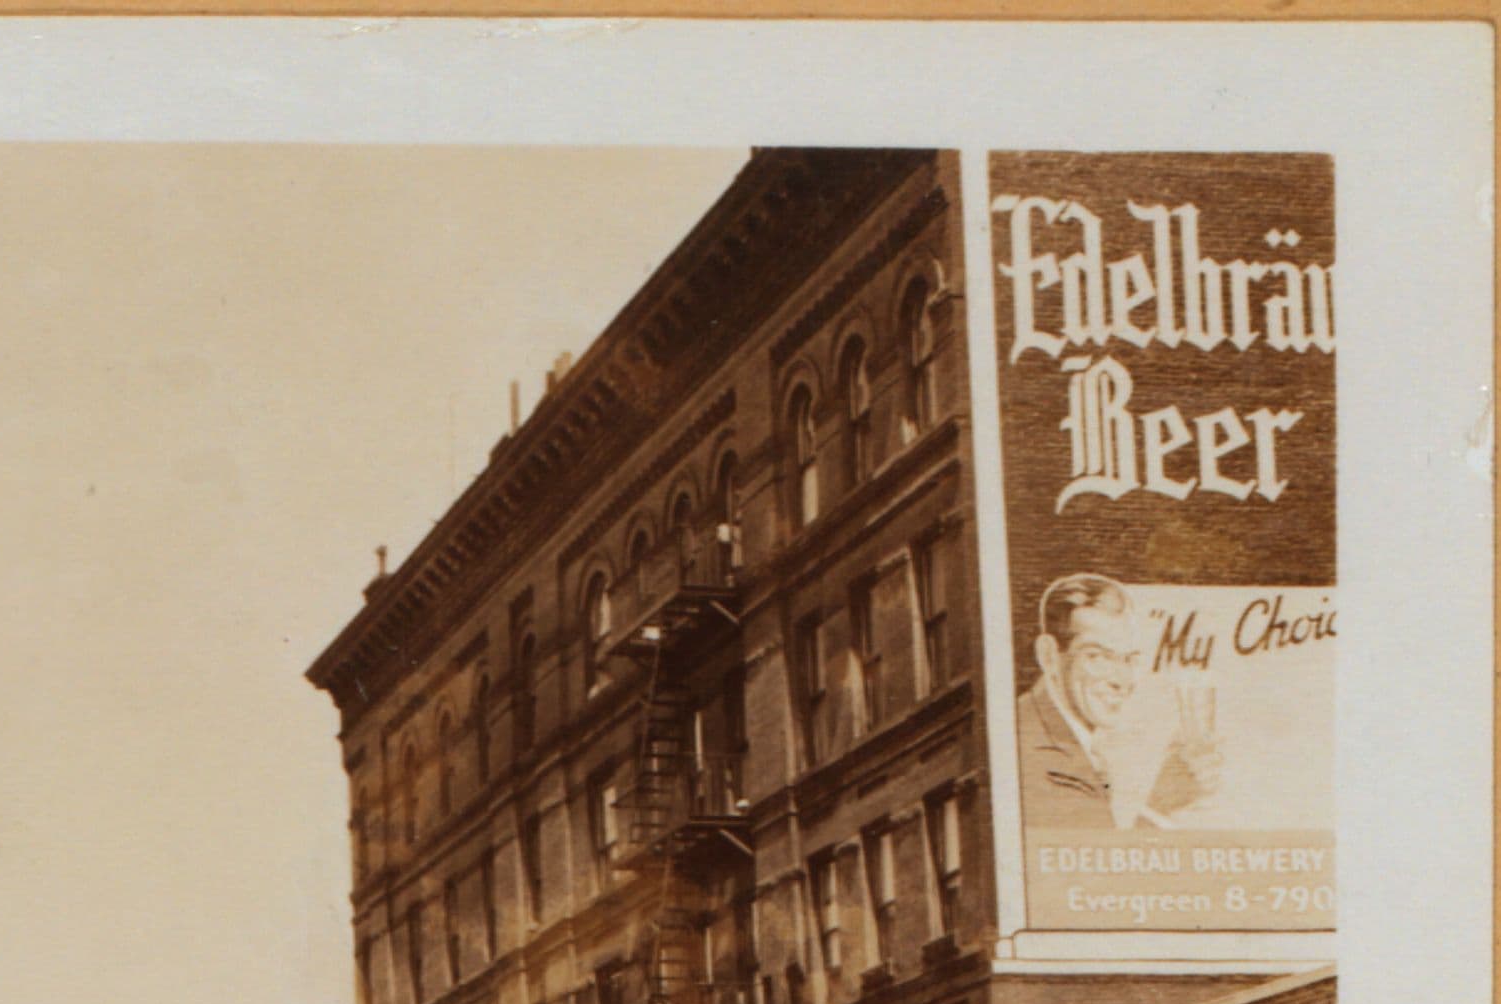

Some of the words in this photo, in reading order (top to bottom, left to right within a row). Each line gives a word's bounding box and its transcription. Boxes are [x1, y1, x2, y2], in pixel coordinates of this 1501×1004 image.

[1055, 355, 1304, 514] Beer
[1192, 847, 1325, 873] BREWERY
[1067, 885, 1212, 923] Evergreen
